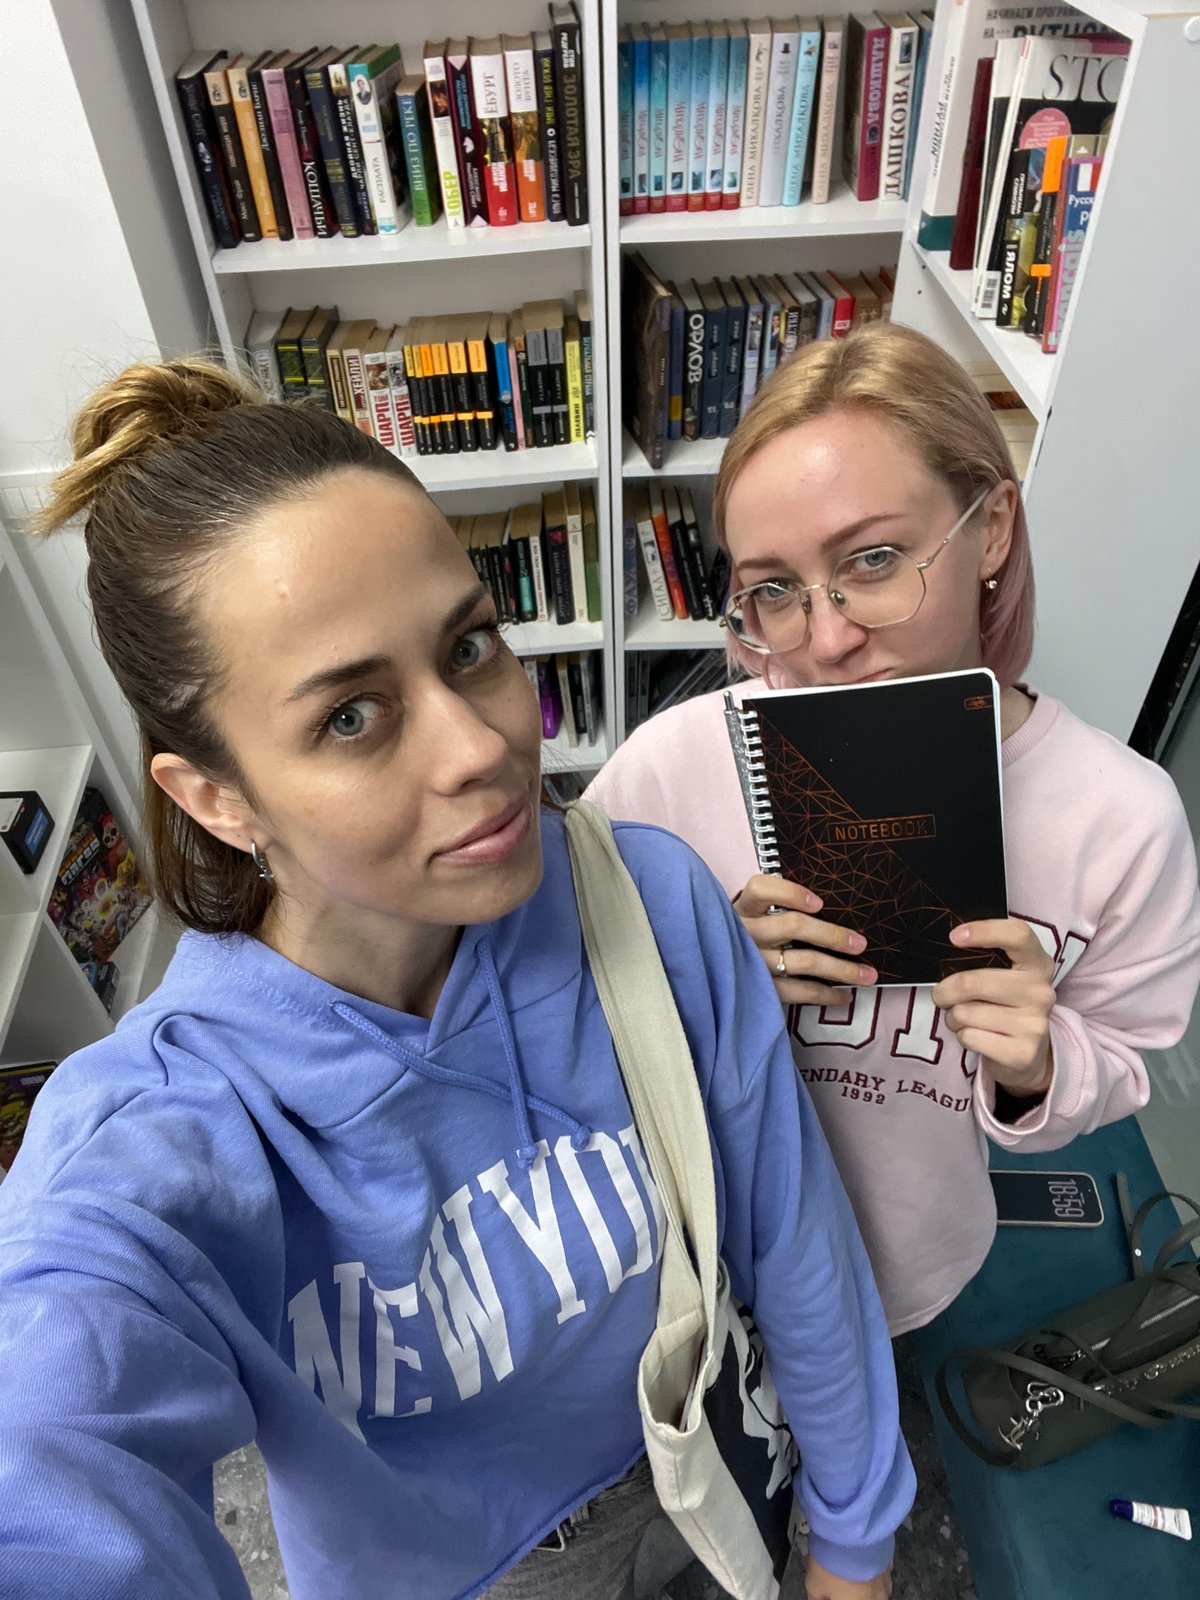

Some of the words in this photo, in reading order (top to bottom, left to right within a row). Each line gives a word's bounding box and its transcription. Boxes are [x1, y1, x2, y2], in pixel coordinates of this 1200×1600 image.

[483, 74, 498, 114] ЁБУРГ
[513, 63, 523, 101] ЗОЛОТО
[523, 70, 531, 102] БУНТА
[866, 37, 885, 124] ДАШКОВА
[337, 99, 348, 133] ЖИЗНЬ
[401, 97, 416, 129] РЕКЕ
[562, 73, 581, 149] ЗОЛОТАЯ
[750, 87, 764, 161] МИХАЛКОВА
[773, 85, 787, 155] ИХАЛКОВА
[793, 84, 810, 160] МИХАЛКОВА
[408, 132, 419, 153] ПО
[885, 73, 911, 197] ДАШКОВА
[343, 136, 358, 179] ДВОЙНАЯ
[413, 157, 424, 191] ВНИЗ
[566, 151, 582, 180] ЭРА
[303, 161, 327, 237] КОШАЧЬИ
[373, 156, 386, 204] РАСПЛАТА
[1002, 251, 1018, 299] ЯЛОМ
[687, 313, 704, 384] ОРЛОВ
[347, 355, 364, 396] ХЕЙЛИ
[375, 402, 395, 447] ШАРП
[395, 401, 417, 447] ШАРП
[573, 403, 583, 439] ПЕЛЕВИН
[834, 819, 929, 841] NOTEBOOK
[840, 1086, 886, 1105] 1992
[896, 1079, 972, 1112] LEAGU
[1047, 1179, 1084, 1219] 18:59
[288, 1184, 514, 1446] NEW
